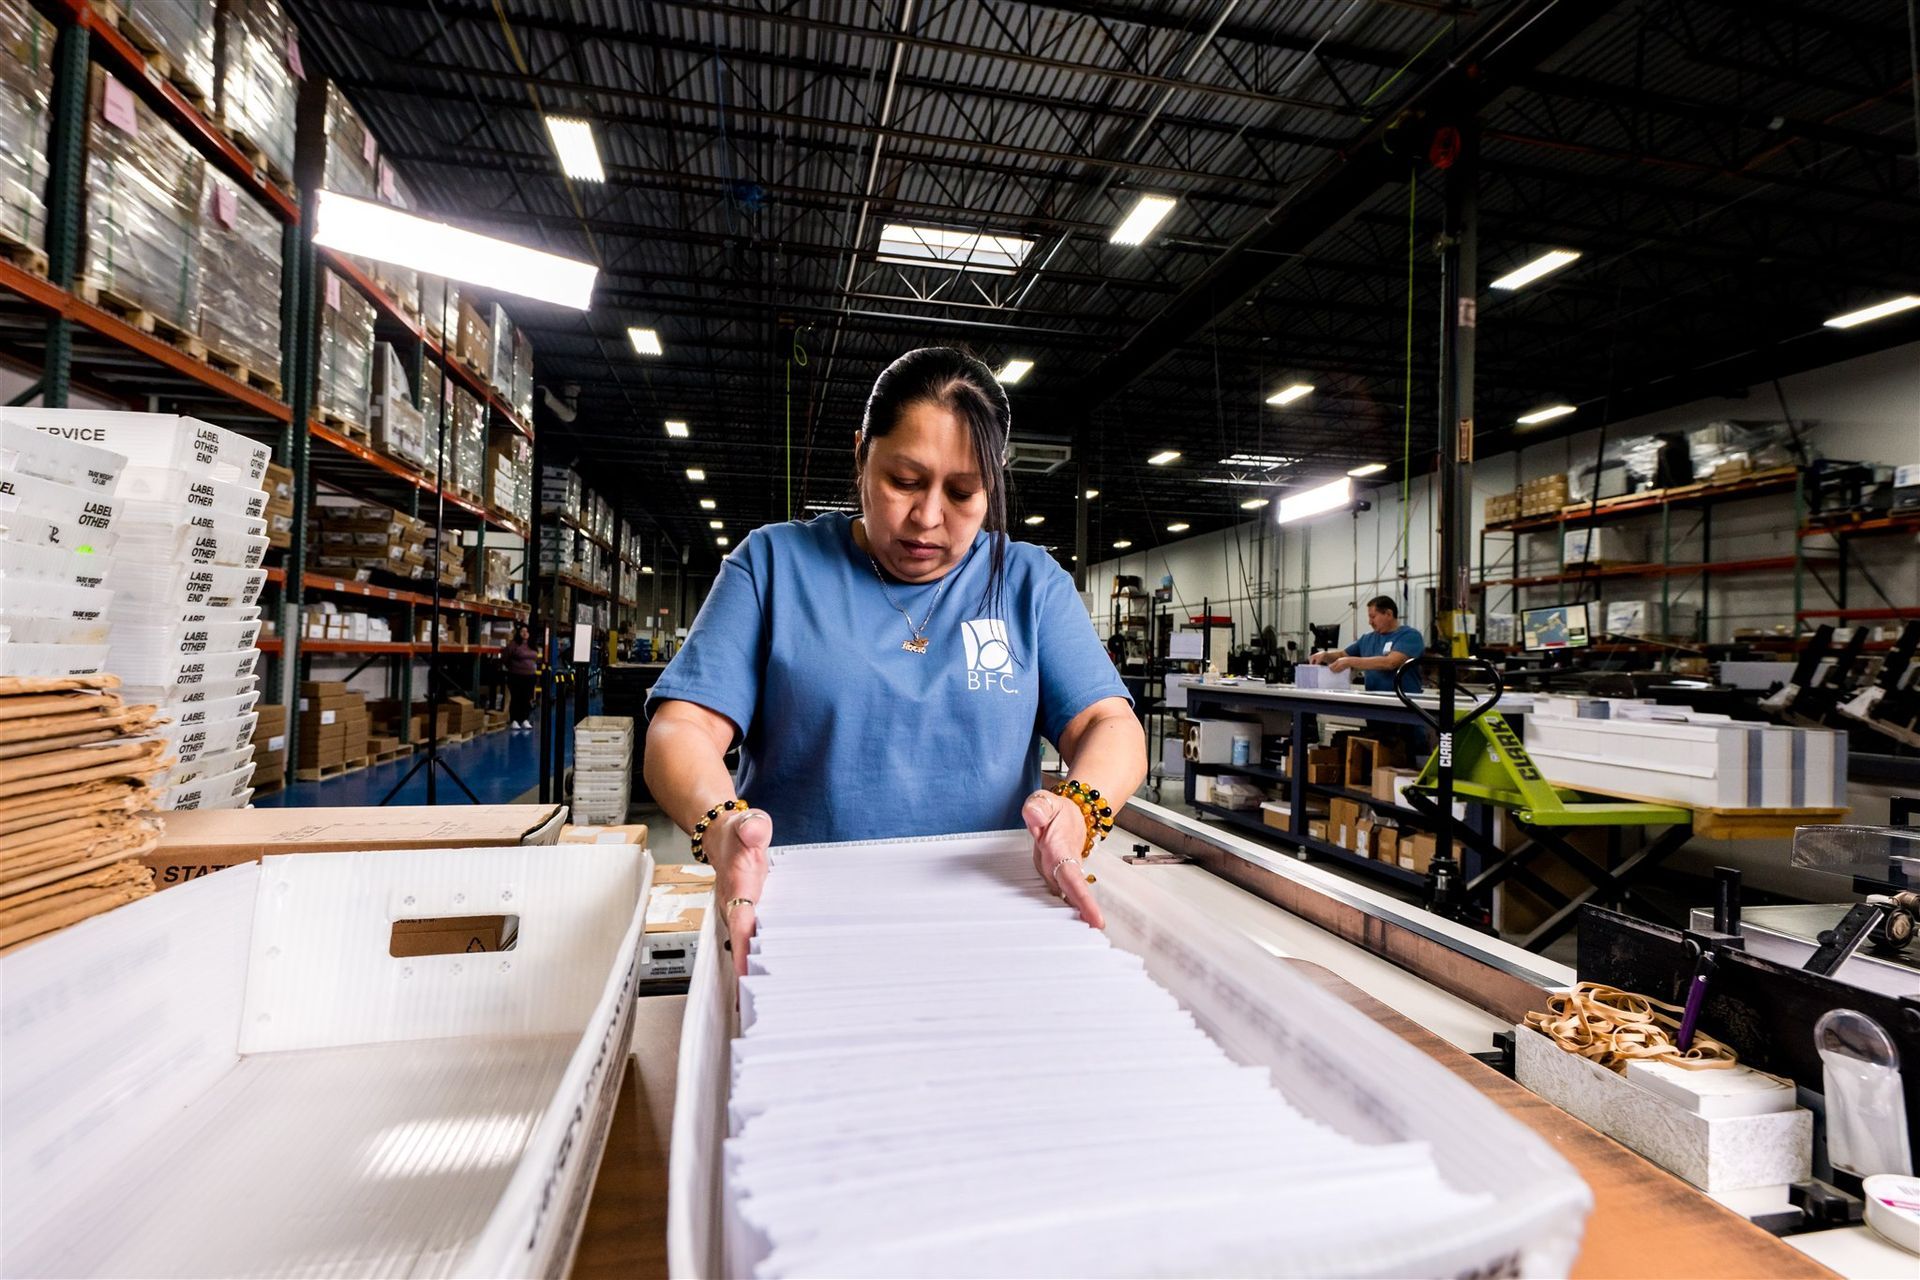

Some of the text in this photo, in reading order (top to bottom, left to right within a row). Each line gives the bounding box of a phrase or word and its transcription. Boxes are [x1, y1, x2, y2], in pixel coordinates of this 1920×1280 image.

[197, 428, 219, 444] LABEL
[194, 440, 218, 455] OTHER
[196, 452, 212, 464] END
[191, 483, 214, 496] LABEL
[188, 494, 213, 507] OTHER
[84, 502, 112, 517] LABEL
[78, 514, 110, 529] OTHER
[191, 516, 214, 528] LABEL
[196, 537, 217, 548] LABEL
[192, 548, 216, 559] OTHER
[190, 572, 213, 582] LABEL
[186, 582, 211, 592] OTHER
[187, 594, 203, 602] END
[184, 632, 208, 640] LABEL
[181, 643, 206, 651] OTHER
[181, 664, 205, 673] LABEL
[177, 674, 203, 684] OTHER
[183, 692, 205, 702] LABEL
[182, 712, 205, 722] LABEL
[183, 732, 206, 743] LABEL
[179, 742, 204, 753] OTHER
[1440, 732, 1452, 767] CLARK
[1488, 720, 1541, 780] CLARK
[177, 791, 201, 804] LABEL
